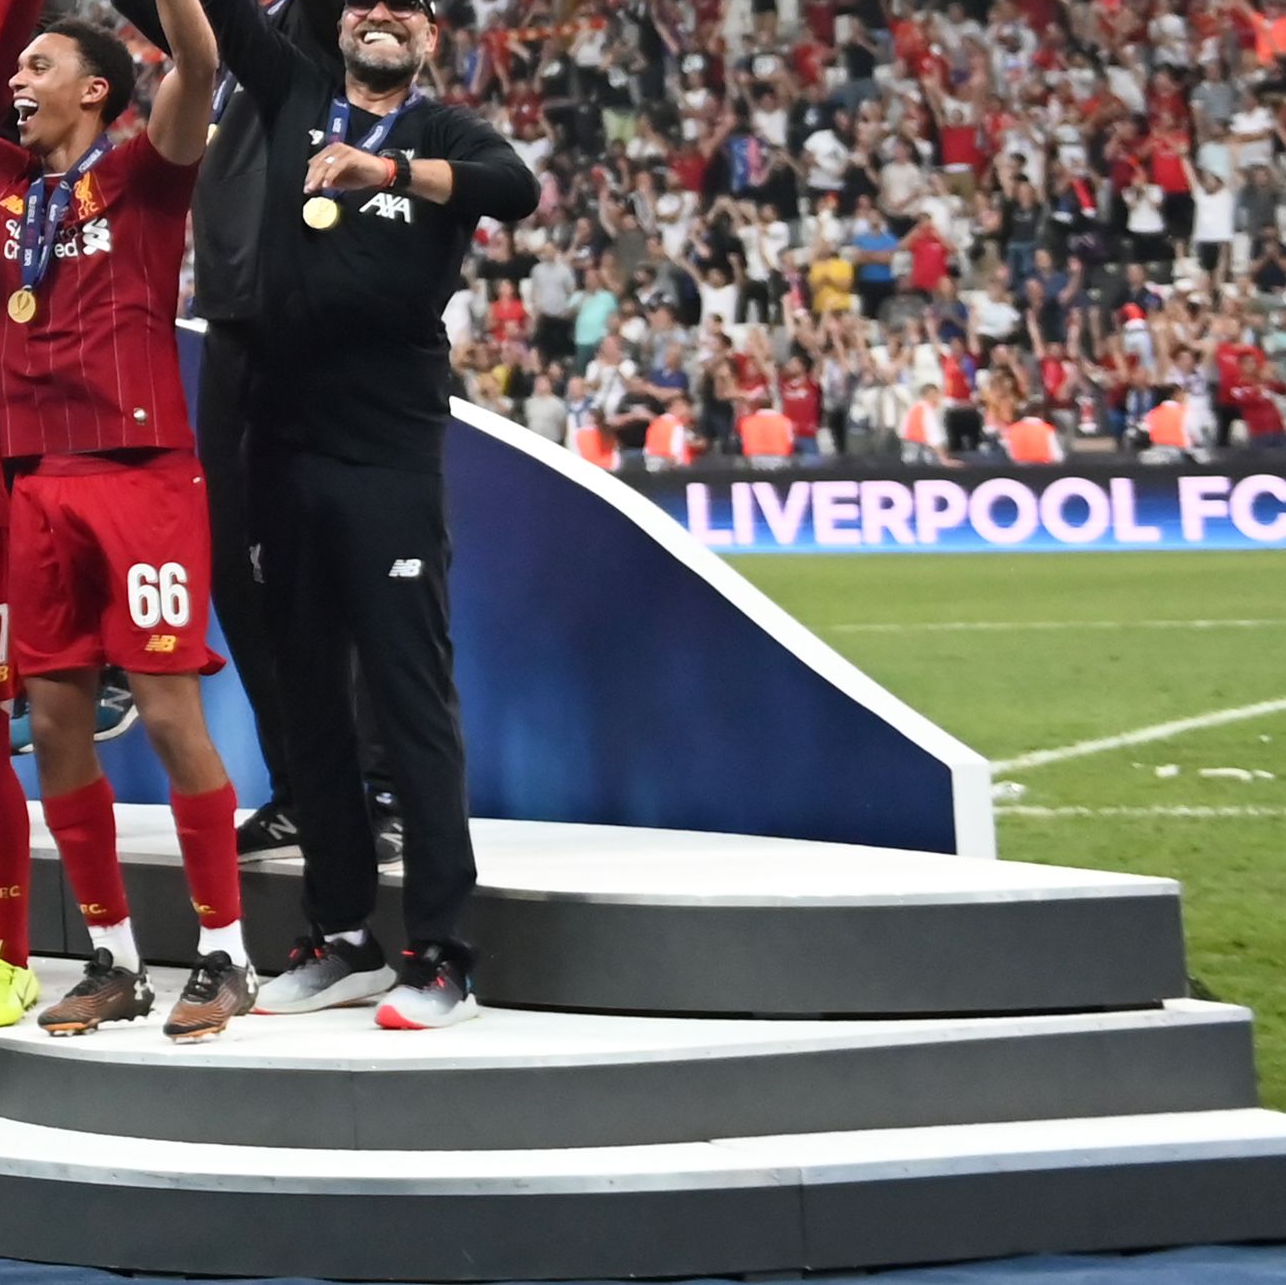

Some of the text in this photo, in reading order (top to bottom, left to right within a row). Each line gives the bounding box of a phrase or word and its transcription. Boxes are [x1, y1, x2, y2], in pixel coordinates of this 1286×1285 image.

[359, 193, 411, 223] AXA
[686, 474, 1286, 546] LIVERPOOL FC
[127, 562, 190, 629] 66
[144, 634, 177, 652] NB
